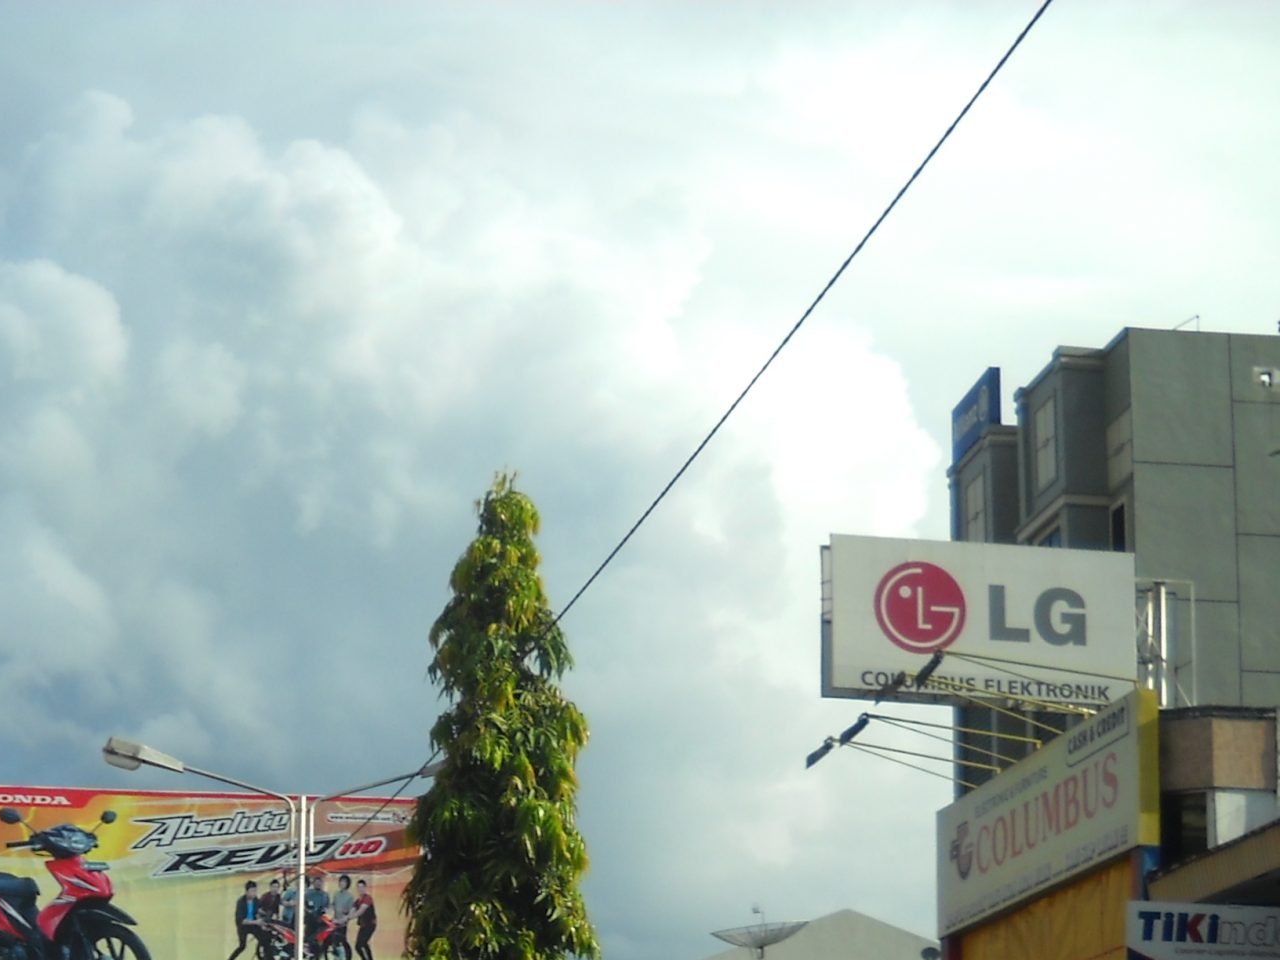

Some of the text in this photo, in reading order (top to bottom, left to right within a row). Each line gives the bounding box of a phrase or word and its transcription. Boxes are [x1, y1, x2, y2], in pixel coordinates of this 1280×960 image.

[988, 583, 1088, 647] LG
[983, 678, 1110, 701] ELEKTRONIK
[131, 808, 290, 850] Absolute
[975, 751, 1119, 875] COLUMBUS
